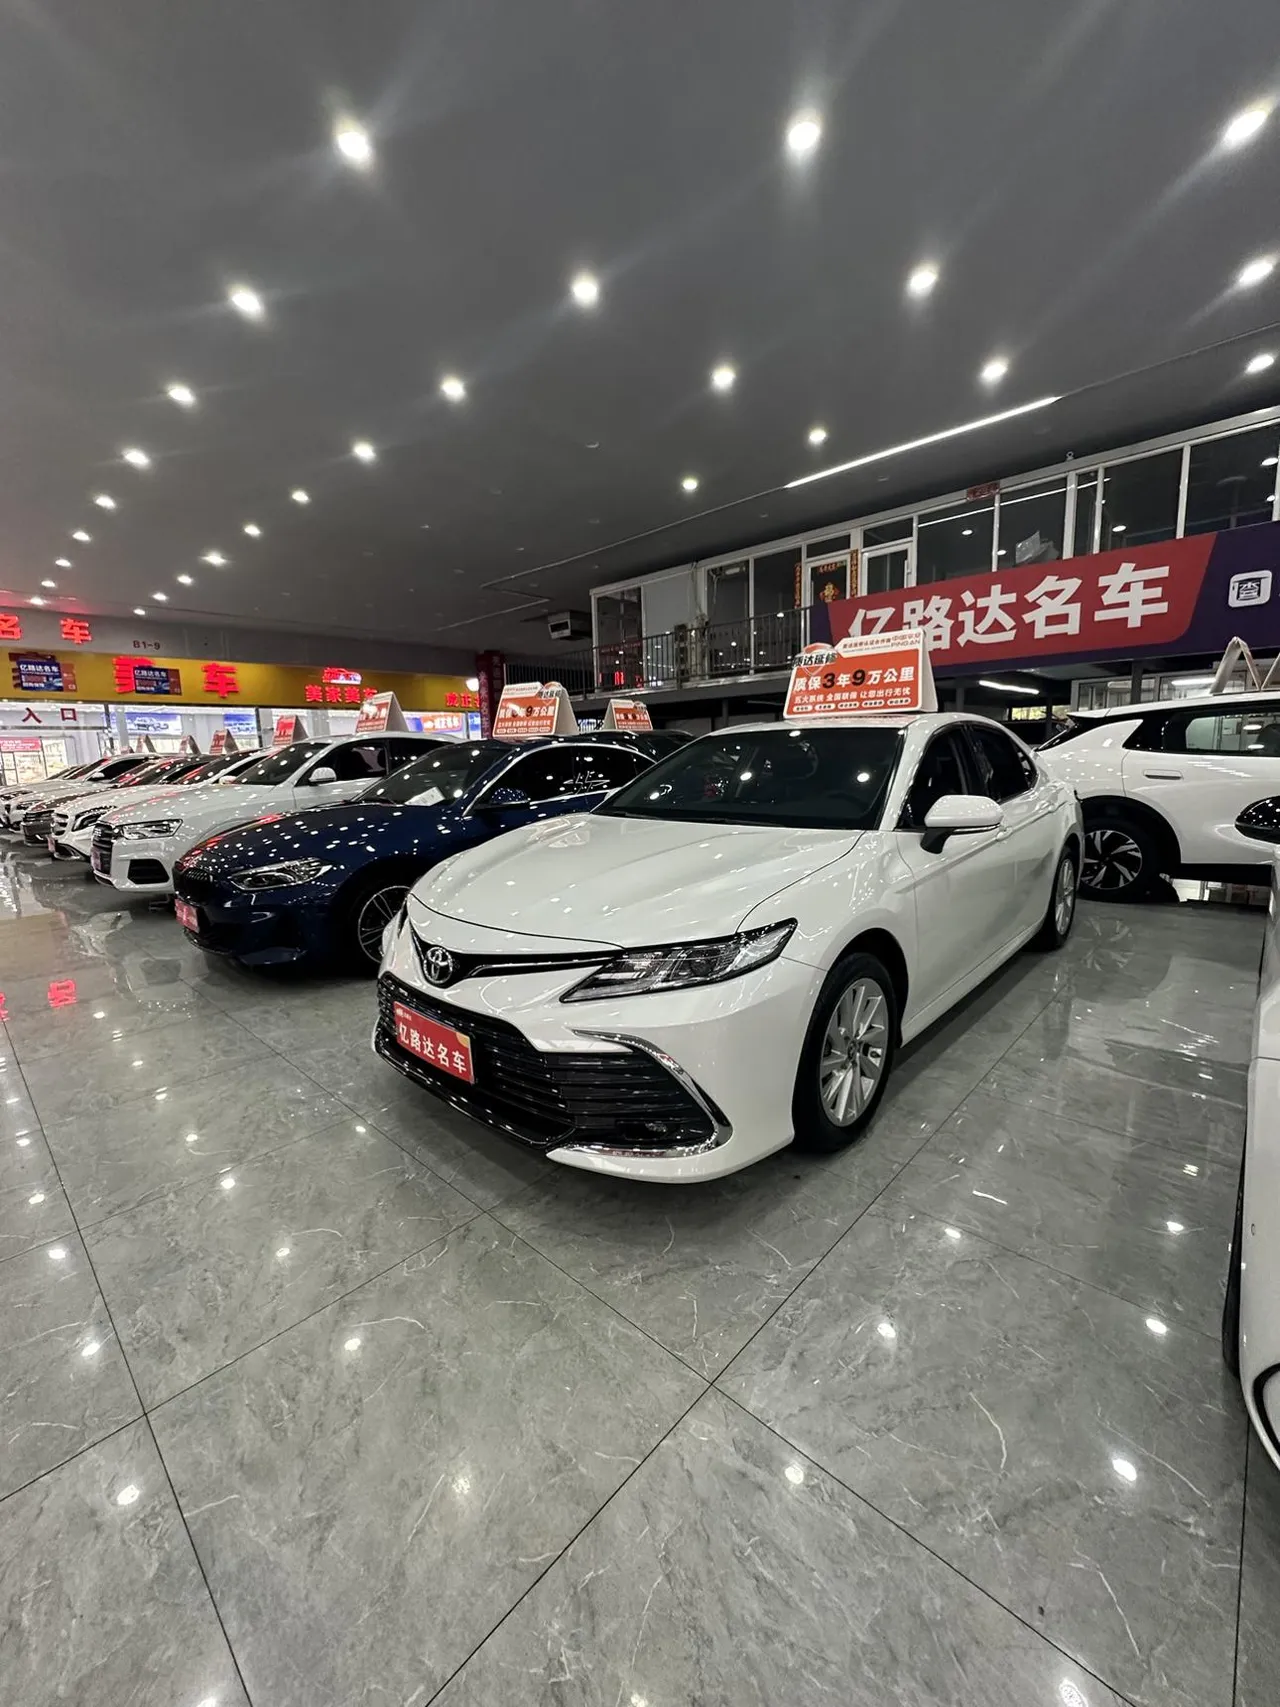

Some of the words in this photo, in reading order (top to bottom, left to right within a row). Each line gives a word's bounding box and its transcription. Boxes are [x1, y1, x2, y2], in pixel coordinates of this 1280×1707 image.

[848, 562, 1170, 651] 亿路达名车
[133, 640, 161, 650] B1-9
[793, 666, 915, 693] 质保3年9万公里
[22, 706, 77, 723] 入口
[398, 1021, 467, 1074] 亿路达名车
